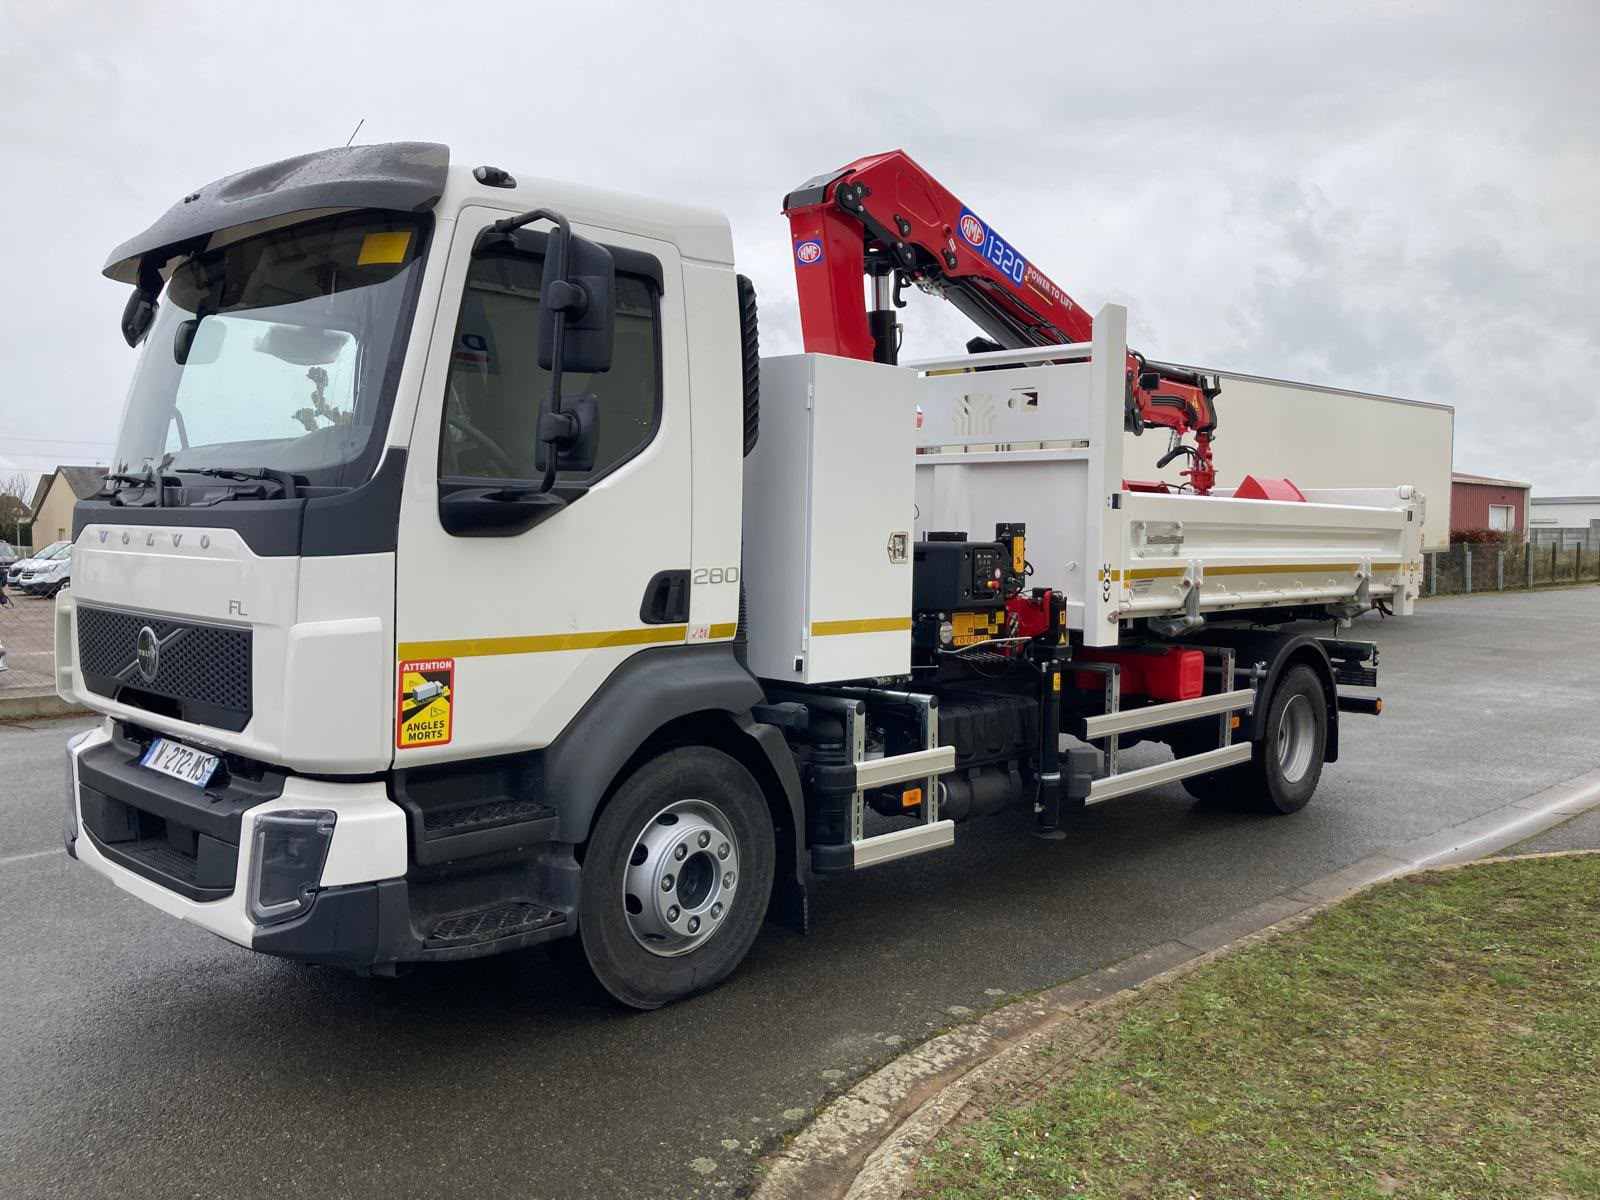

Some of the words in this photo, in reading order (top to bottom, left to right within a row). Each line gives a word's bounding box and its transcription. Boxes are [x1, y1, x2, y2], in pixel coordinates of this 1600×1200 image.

[963, 218, 982, 243] HMF
[800, 245, 818, 260] HMF
[986, 235, 1025, 283] 1320
[1027, 266, 1050, 292] POWER
[1051, 285, 1060, 299] TO
[1060, 294, 1074, 311] LIFT
[99, 530, 210, 549] VOLVO
[693, 566, 740, 585] 280
[229, 600, 248, 616] FL
[403, 660, 452, 672] ATTENTION
[407, 720, 445, 733] ANGLES
[408, 730, 443, 742] MORTS
